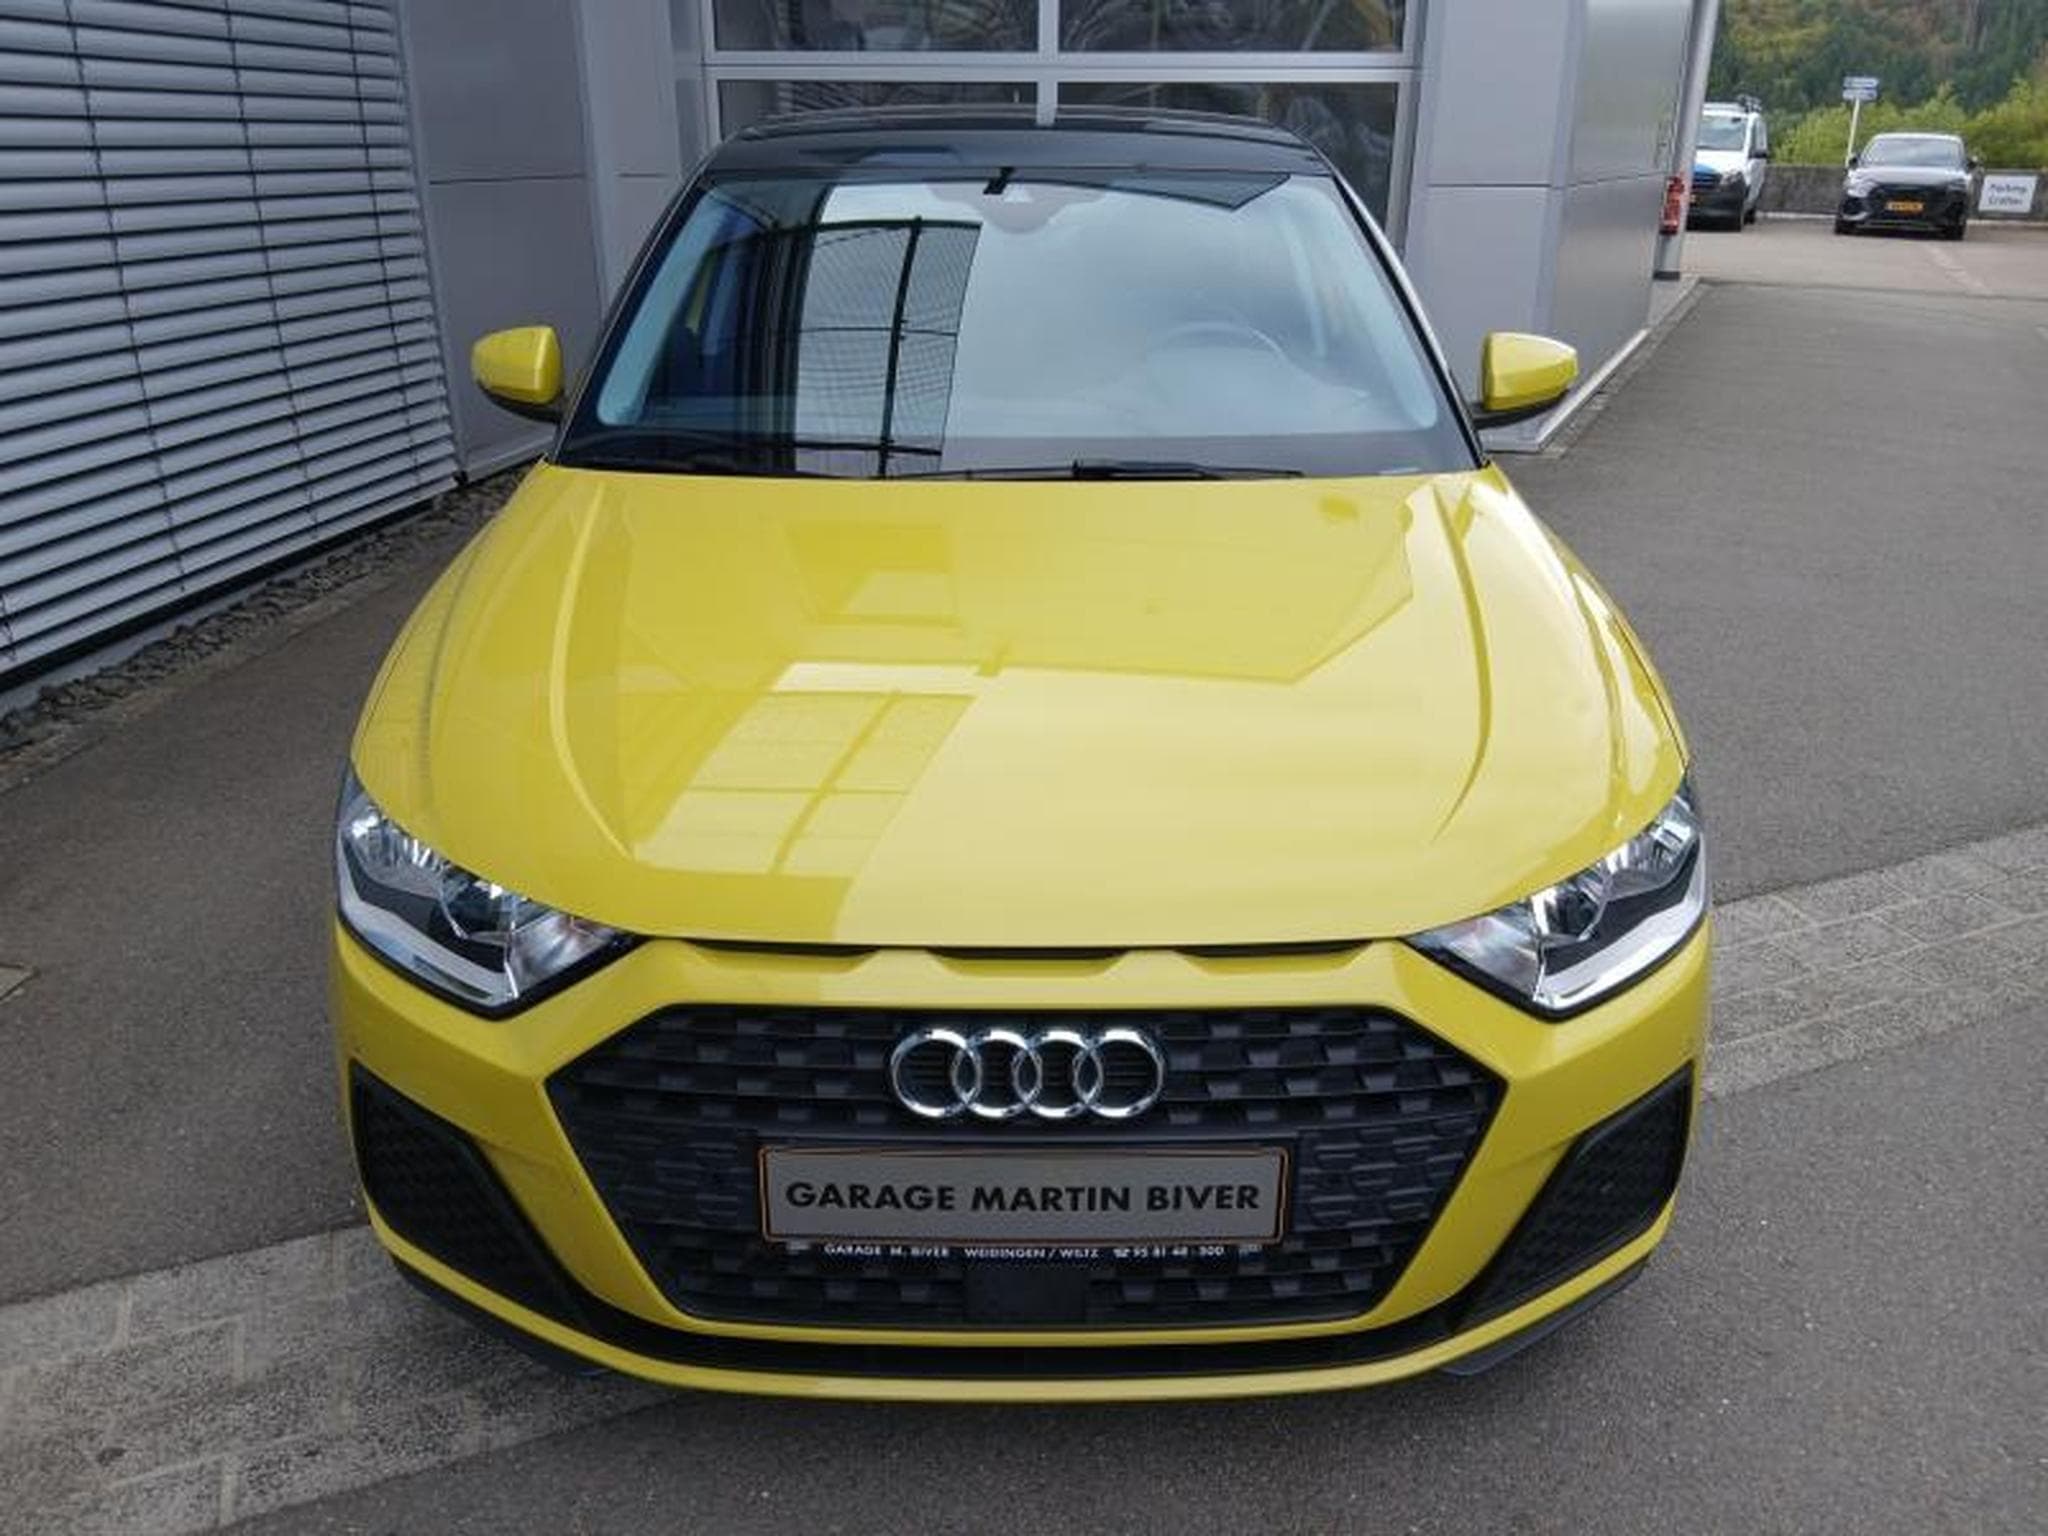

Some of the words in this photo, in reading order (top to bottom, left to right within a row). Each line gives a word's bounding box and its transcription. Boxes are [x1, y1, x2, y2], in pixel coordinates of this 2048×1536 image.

[785, 1181, 955, 1211] GARAGE
[970, 1186, 1130, 1212] MARTIN
[1146, 1184, 1260, 1211] BIVER
[824, 1244, 881, 1256] GARAGE
[911, 1246, 949, 1257] BIVER
